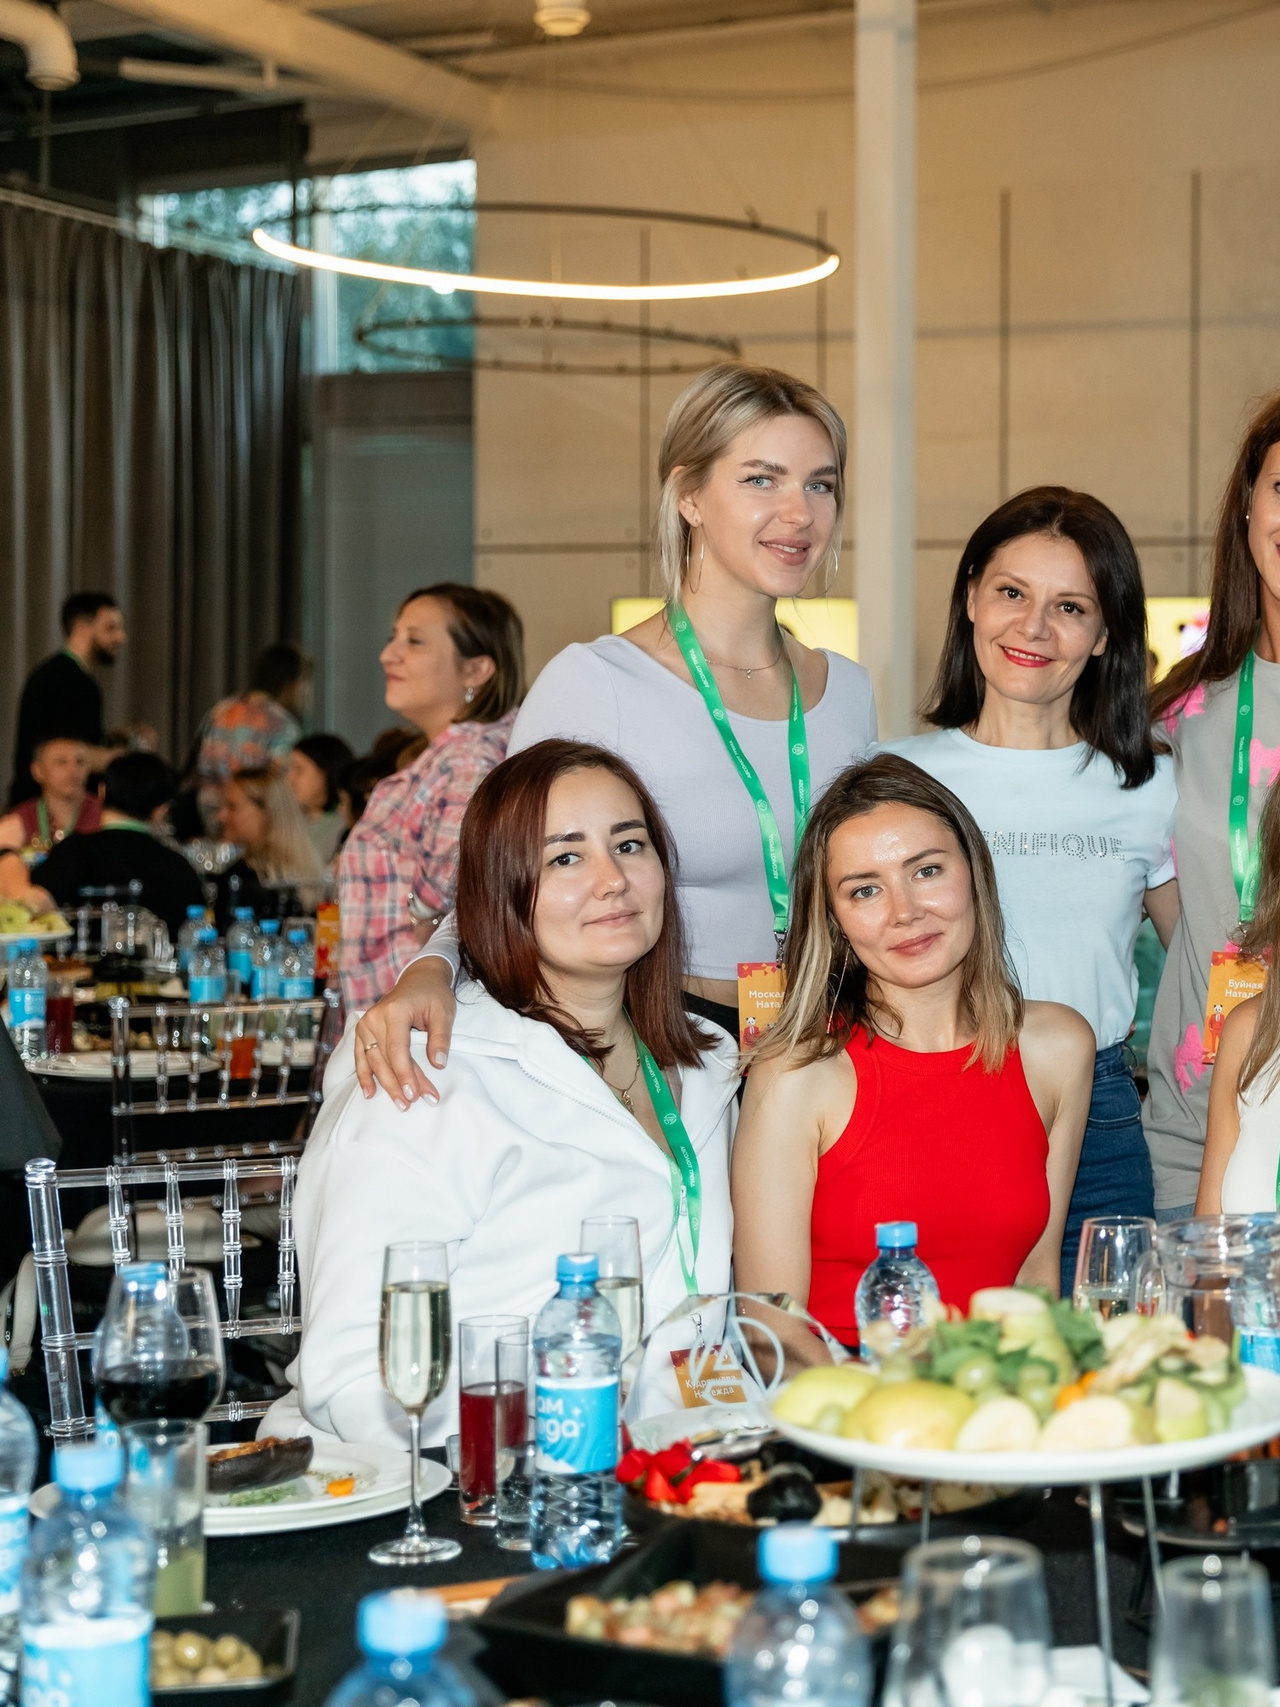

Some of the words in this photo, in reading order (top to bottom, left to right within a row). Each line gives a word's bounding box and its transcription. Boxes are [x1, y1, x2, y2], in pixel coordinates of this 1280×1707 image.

[1228, 979, 1263, 989] Буйная
[1225, 989, 1256, 999] Натал
[756, 1000, 781, 1009] Ната
[693, 1386, 735, 1399] Нежда
